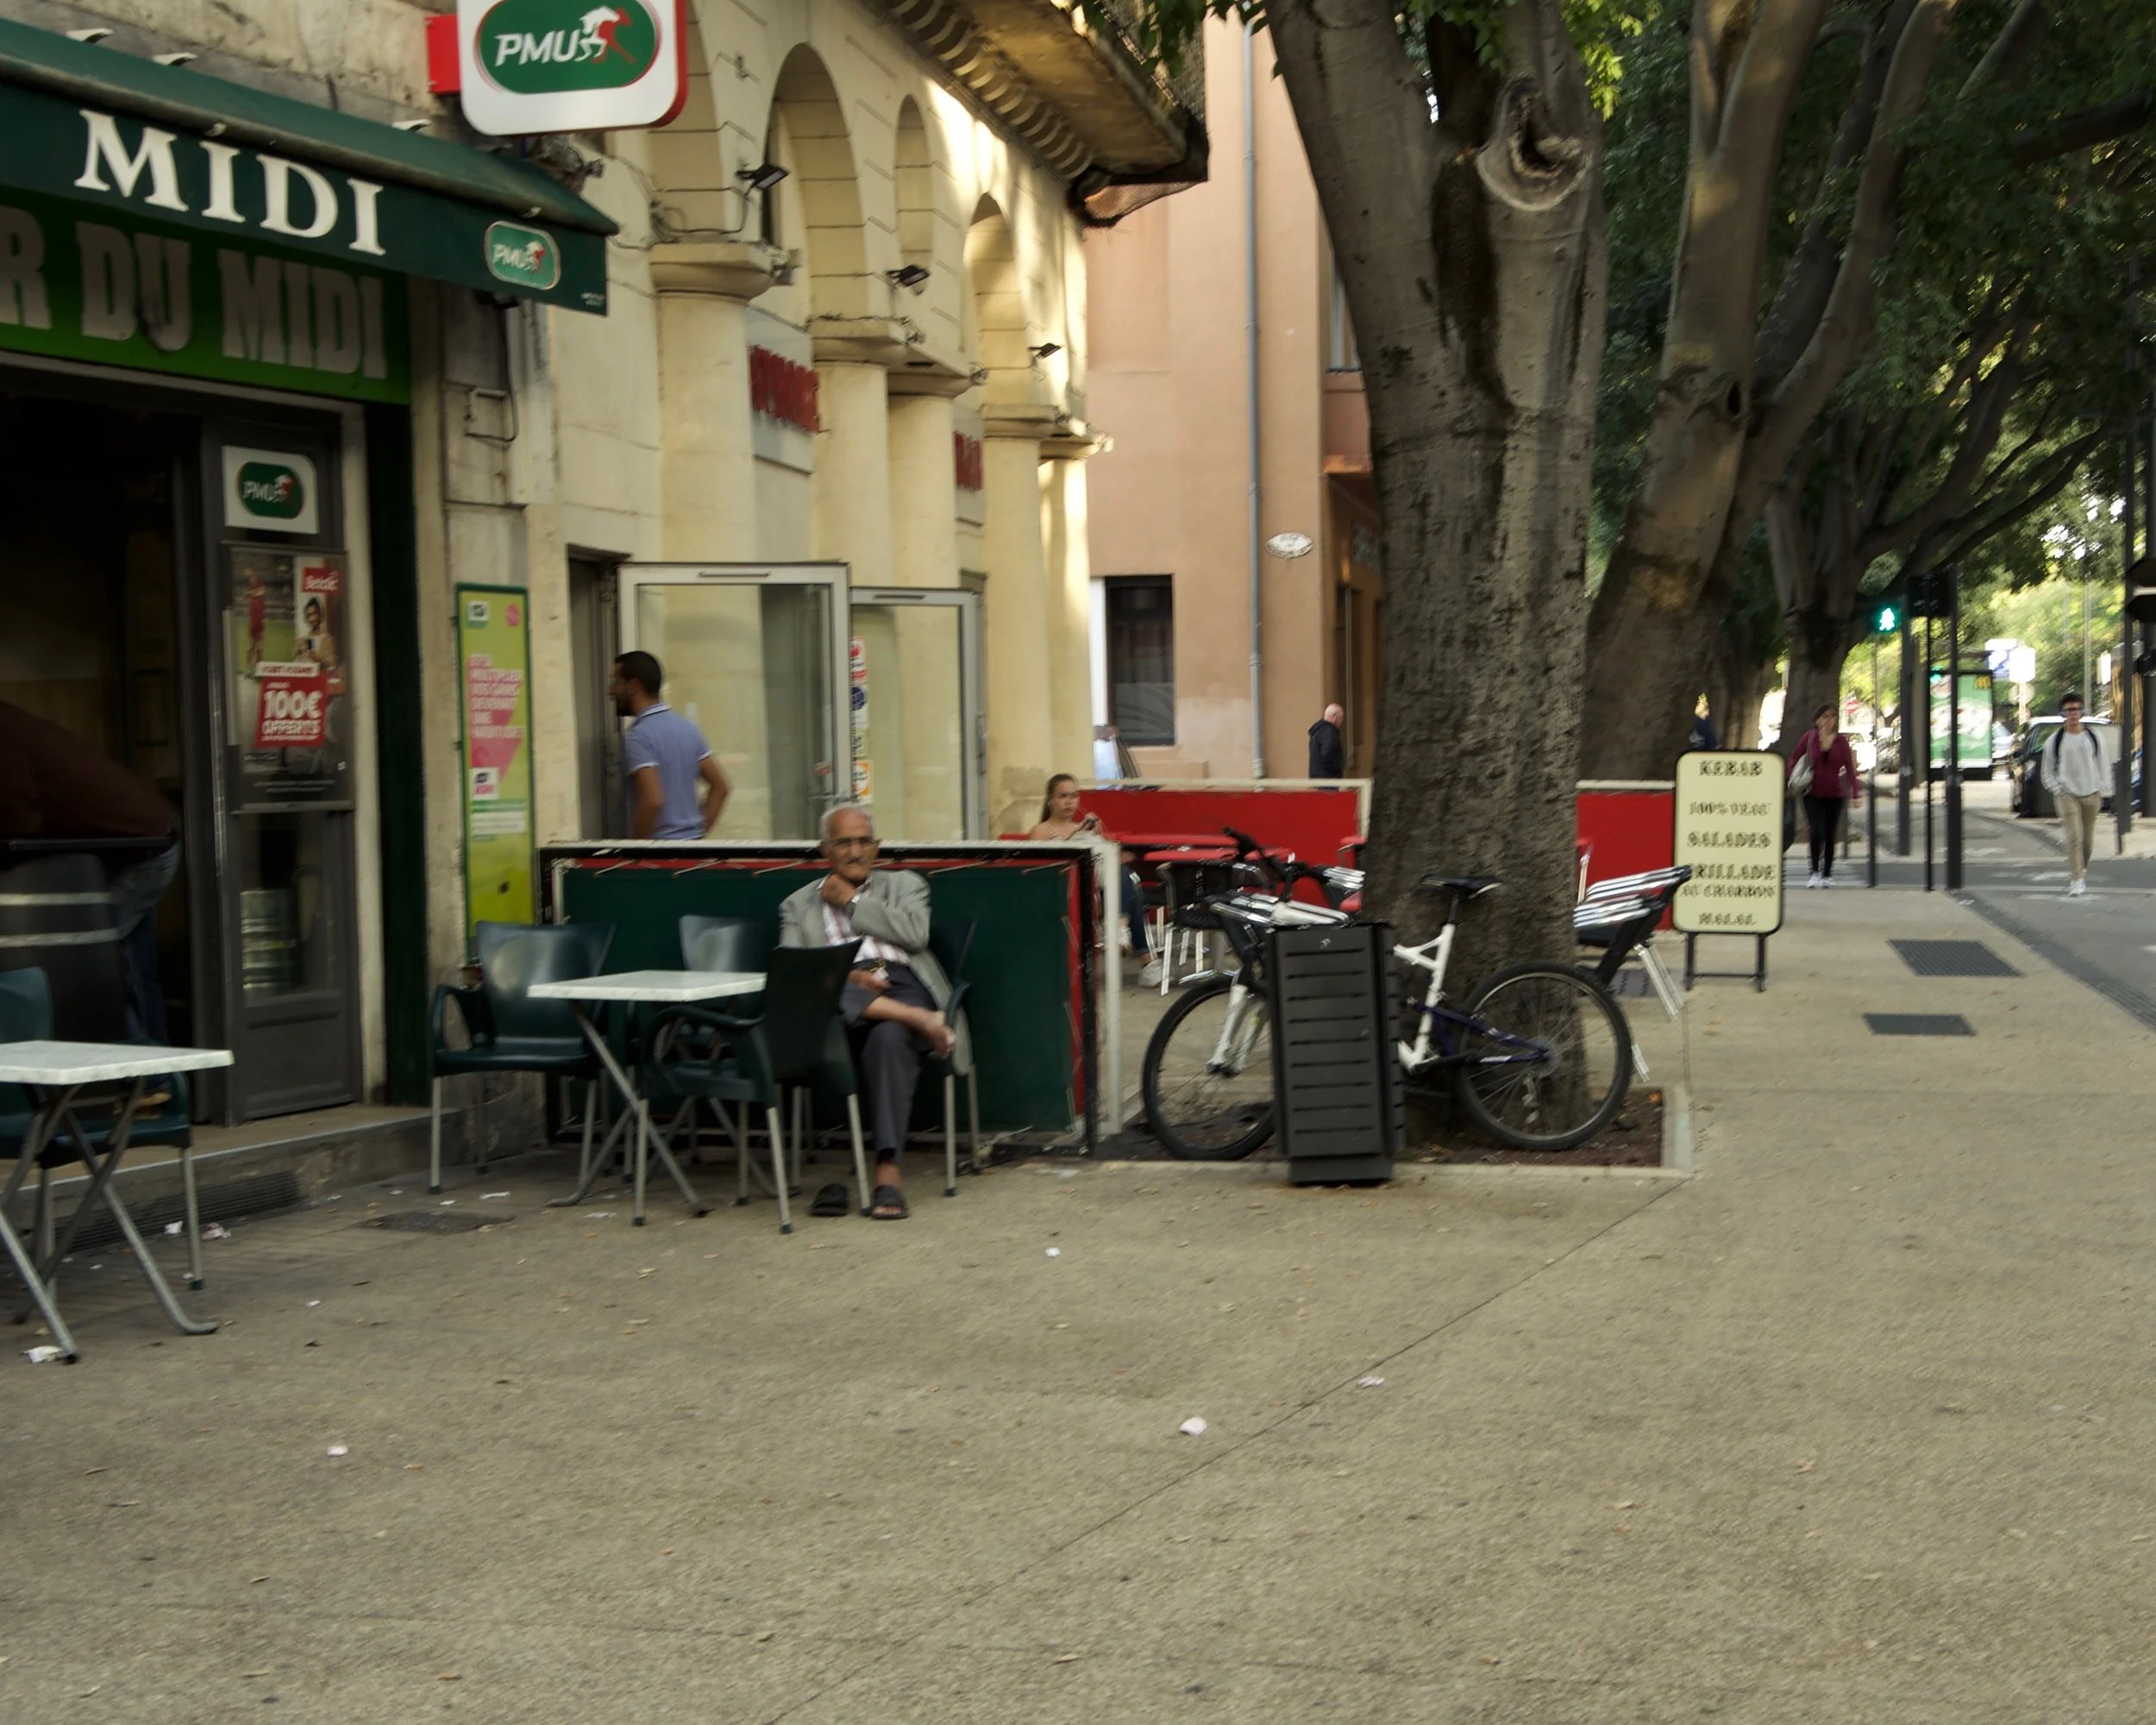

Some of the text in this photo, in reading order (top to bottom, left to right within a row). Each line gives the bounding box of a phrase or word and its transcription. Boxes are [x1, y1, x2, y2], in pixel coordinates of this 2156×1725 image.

[494, 29, 580, 67] PMU
[74, 109, 386, 256] MIDI
[492, 243, 526, 270] PMU
[75, 220, 193, 352] DU
[216, 247, 388, 380] MIDI
[242, 480, 276, 503] PMU
[263, 690, 323, 719] 100€
[1699, 760, 1763, 776] KEBAB
[1689, 801, 1772, 816] 100% VEAU
[1687, 831, 1772, 849] SALADES
[1690, 863, 1777, 881] RILLADE
[1680, 884, 1777, 899] AU CHARBON
[1698, 912, 1757, 926] HALAL
